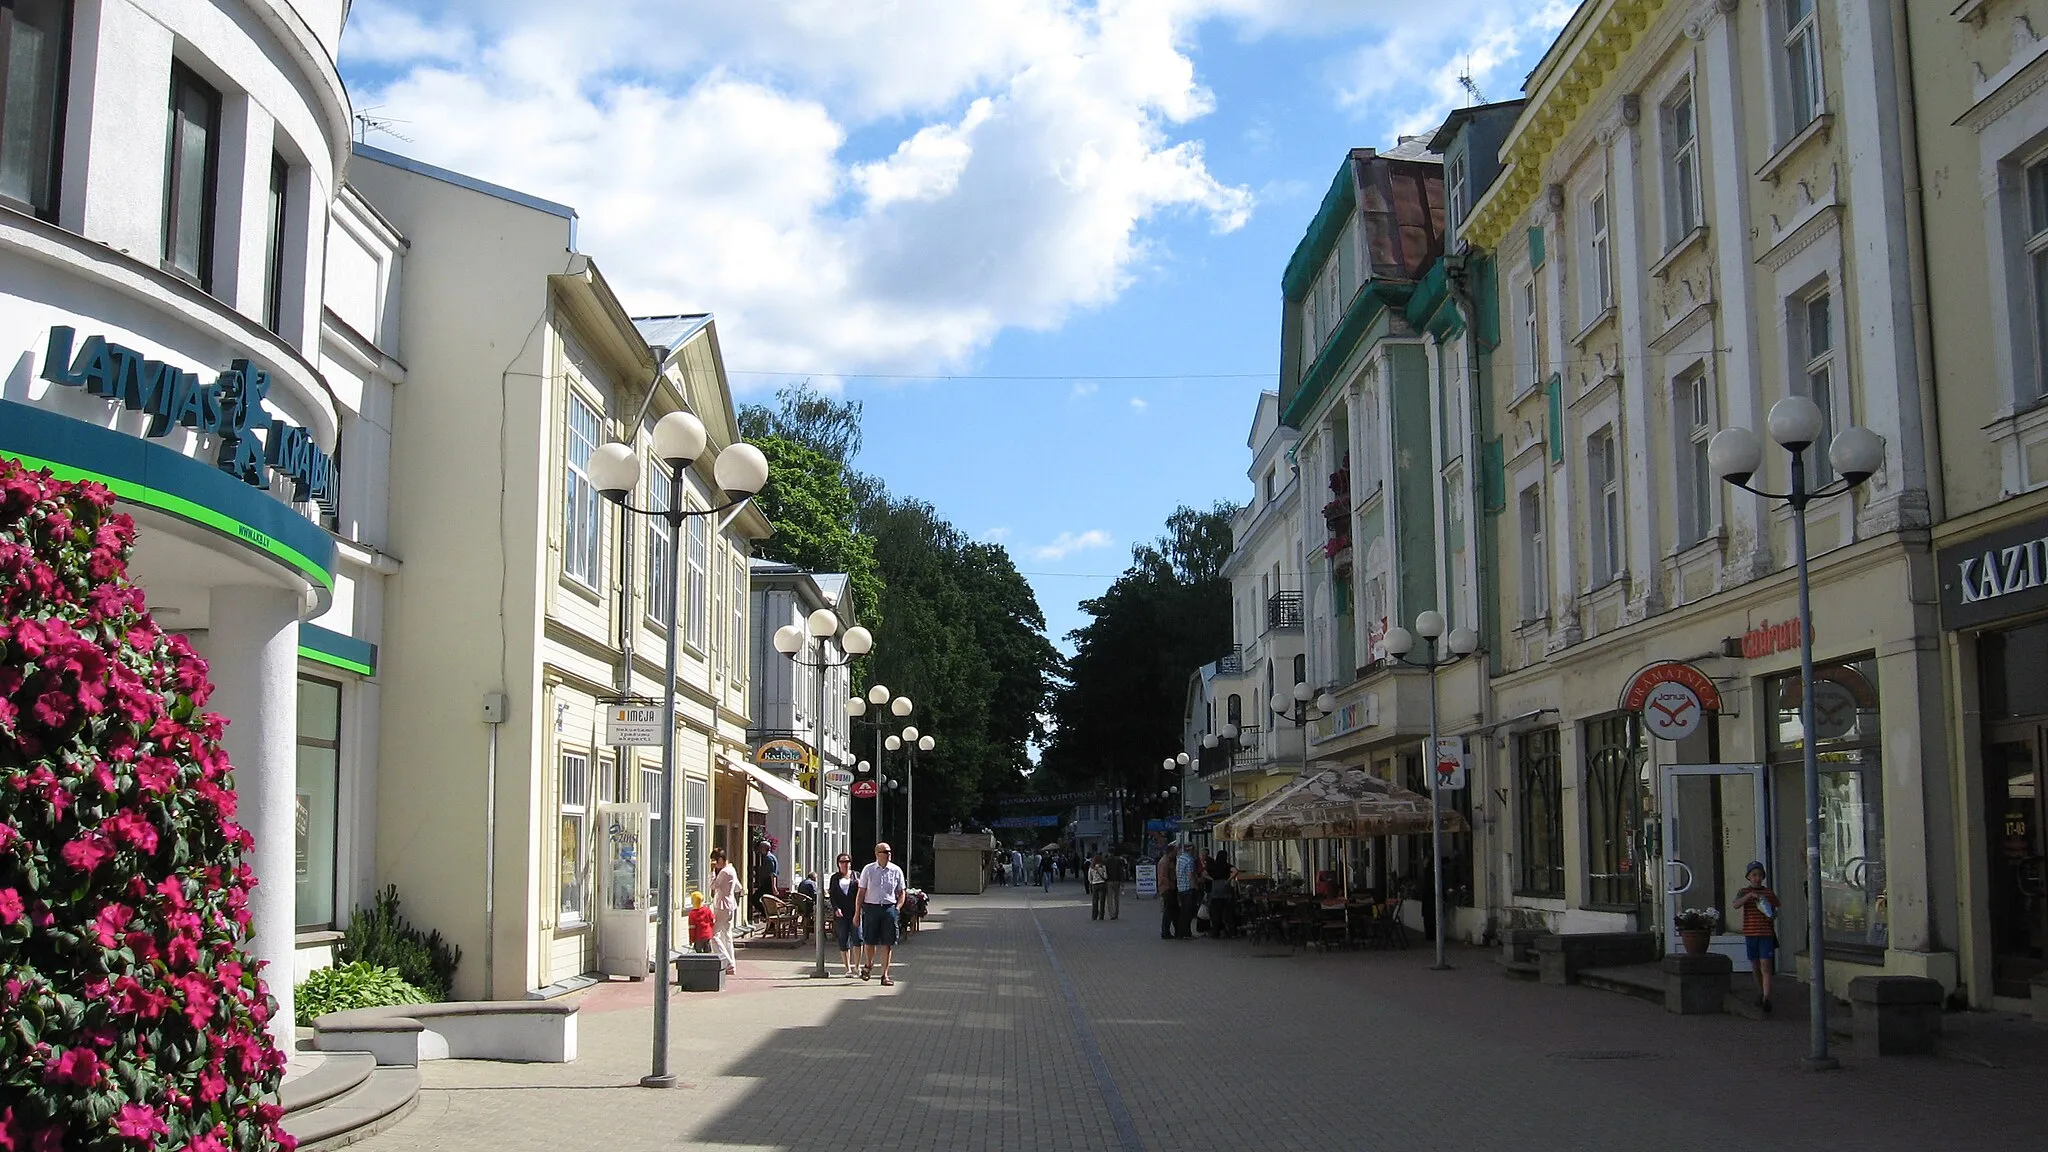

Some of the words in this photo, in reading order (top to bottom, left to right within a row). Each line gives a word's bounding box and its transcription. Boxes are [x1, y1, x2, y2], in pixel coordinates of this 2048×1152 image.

[41, 326, 222, 438] LATVIJAS
[1958, 536, 2048, 606] KAZI
[626, 710, 655, 722] IMEJA
[1658, 691, 1687, 701] Janus
